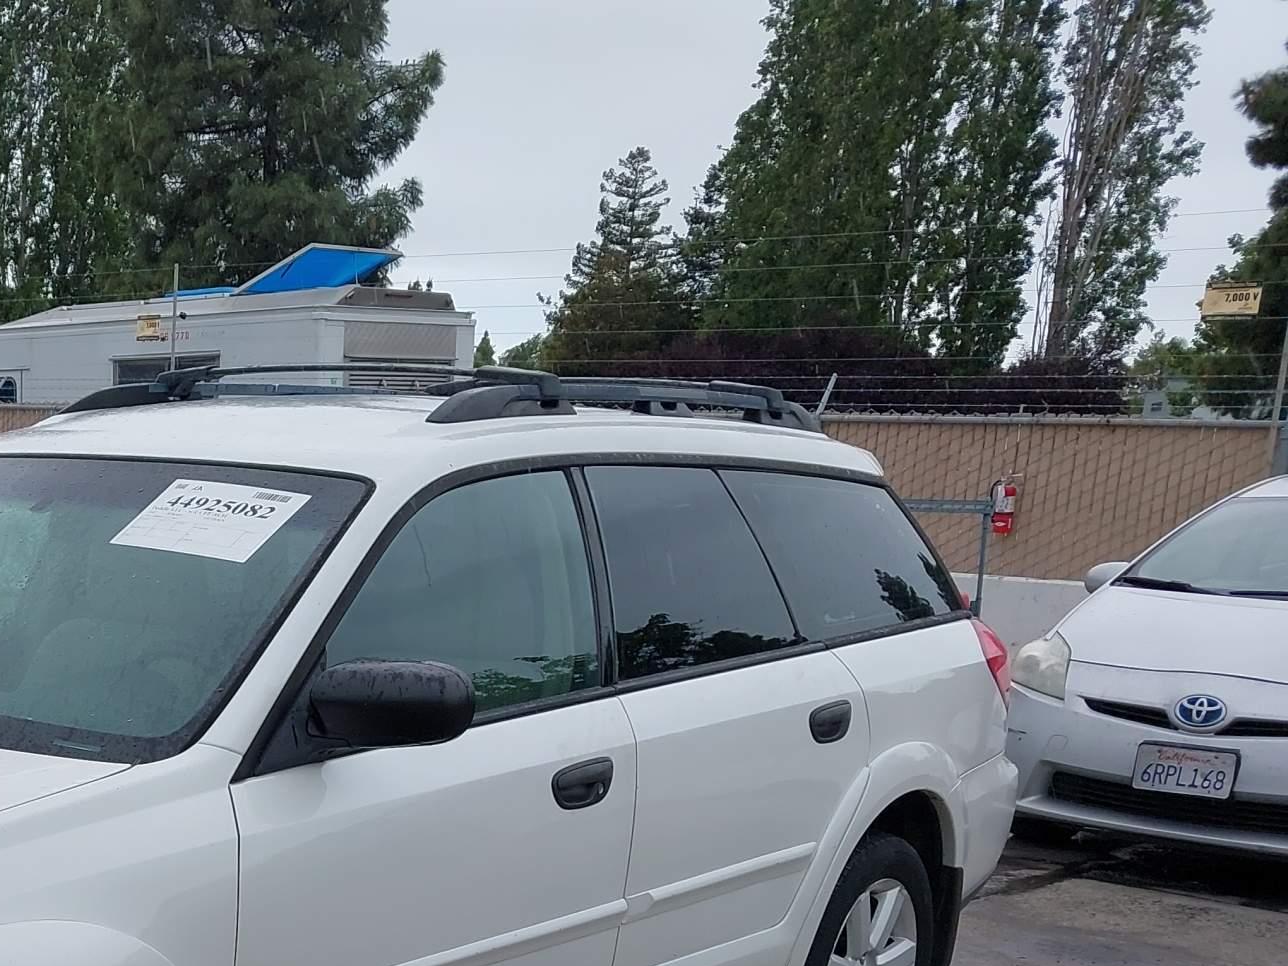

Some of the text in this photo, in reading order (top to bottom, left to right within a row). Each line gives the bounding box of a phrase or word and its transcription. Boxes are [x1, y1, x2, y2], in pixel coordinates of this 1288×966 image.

[1224, 292, 1260, 303] 7,000 V
[167, 495, 276, 519] 44925082
[1140, 763, 1226, 791] 6RPL168
